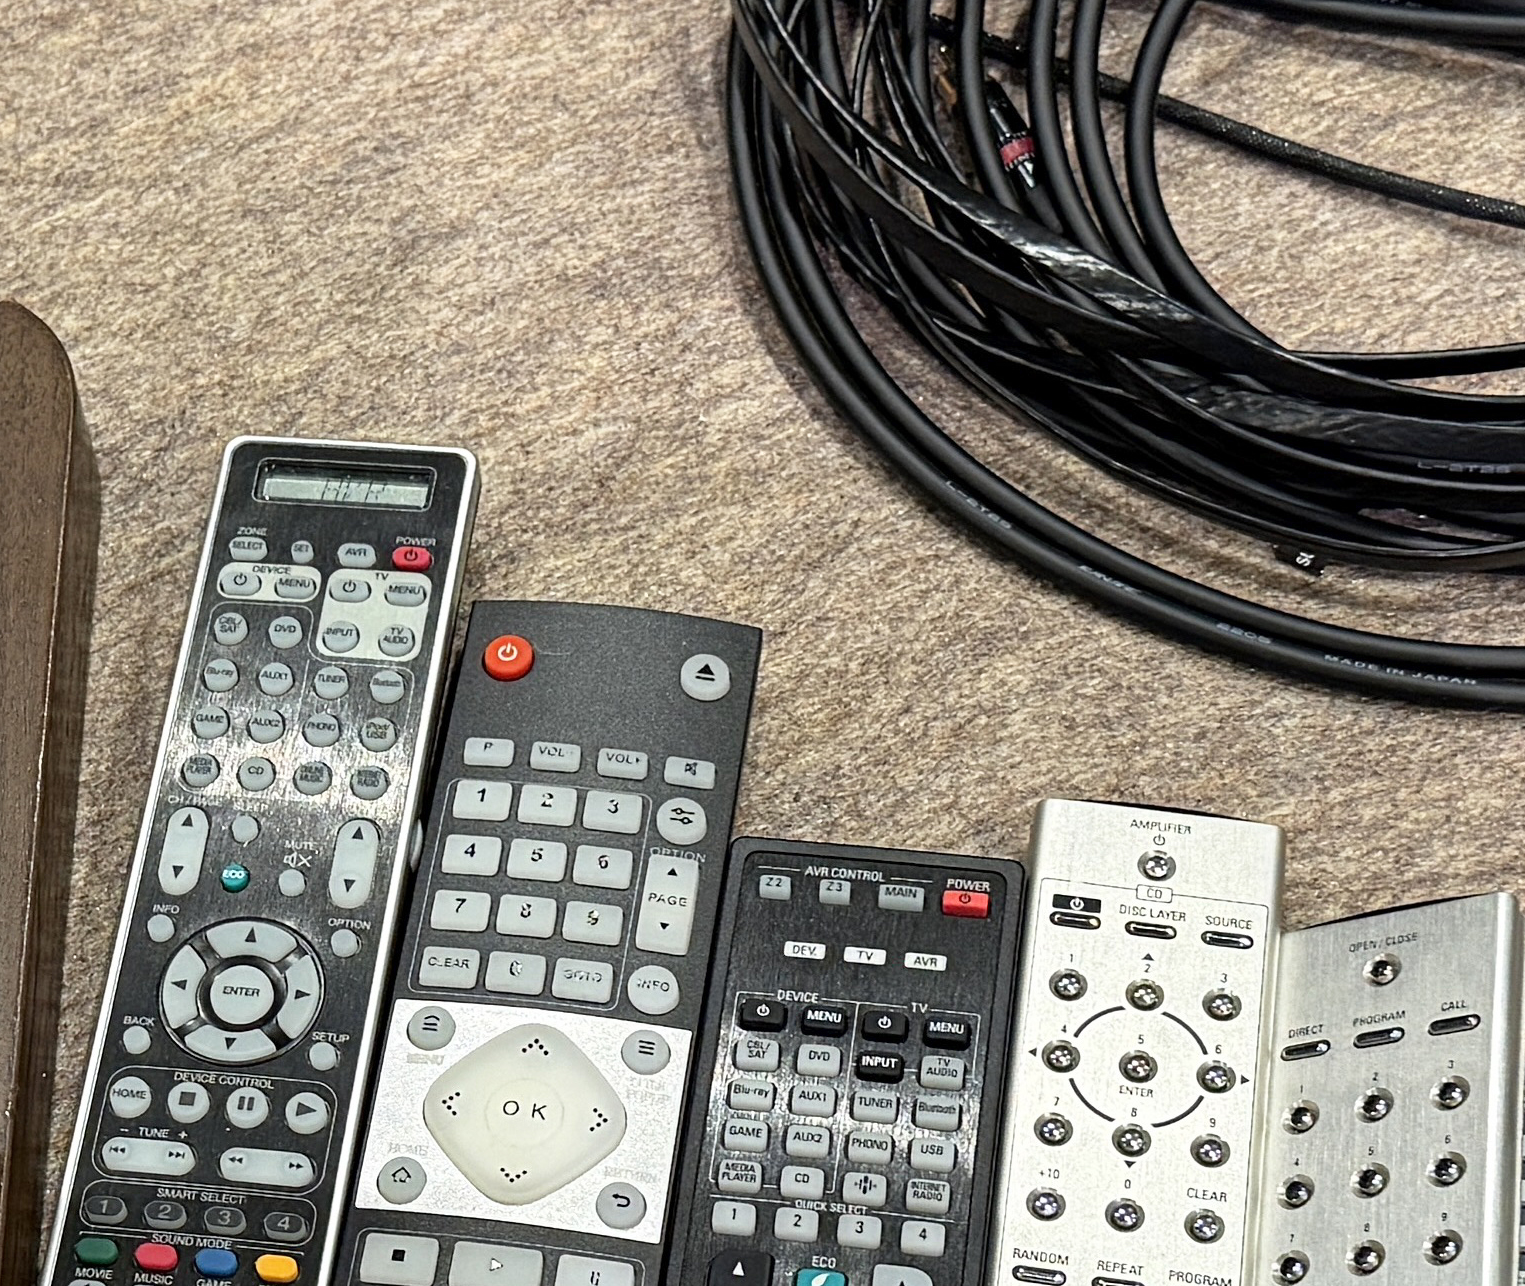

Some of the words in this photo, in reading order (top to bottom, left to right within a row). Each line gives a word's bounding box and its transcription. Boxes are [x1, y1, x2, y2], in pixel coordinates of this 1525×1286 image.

[396, 536, 436, 547] POWER
[1325, 655, 1378, 671] MADE
[1412, 672, 1476, 685] JAPAN
[1130, 819, 1192, 835] AMPLIFIER
[650, 847, 706, 863] OPTION
[946, 879, 990, 892] POWER
[648, 892, 688, 907] PAGE
[328, 918, 371, 930] OPTION
[1205, 916, 1253, 930] SOURCE
[222, 986, 260, 997] ENTER
[123, 1016, 155, 1027] BACK
[807, 1011, 842, 1023] MENU
[929, 1022, 964, 1035] MENU
[312, 1032, 350, 1043] SETUP
[861, 1056, 898, 1069] INPUT
[174, 1072, 216, 1084] DEVICE
[218, 1075, 275, 1089] CONTROL
[112, 1088, 147, 1099] HOME
[156, 1188, 197, 1201] SMART
[199, 1192, 246, 1205] SELECT
[152, 1233, 194, 1247] SOUND
[196, 1236, 232, 1250] MODE
[1013, 1248, 1069, 1266] RANDOM
[75, 1267, 113, 1280] MOVIE
[1097, 1260, 1145, 1276] REPEAT
[134, 1273, 173, 1285] MUSIC
